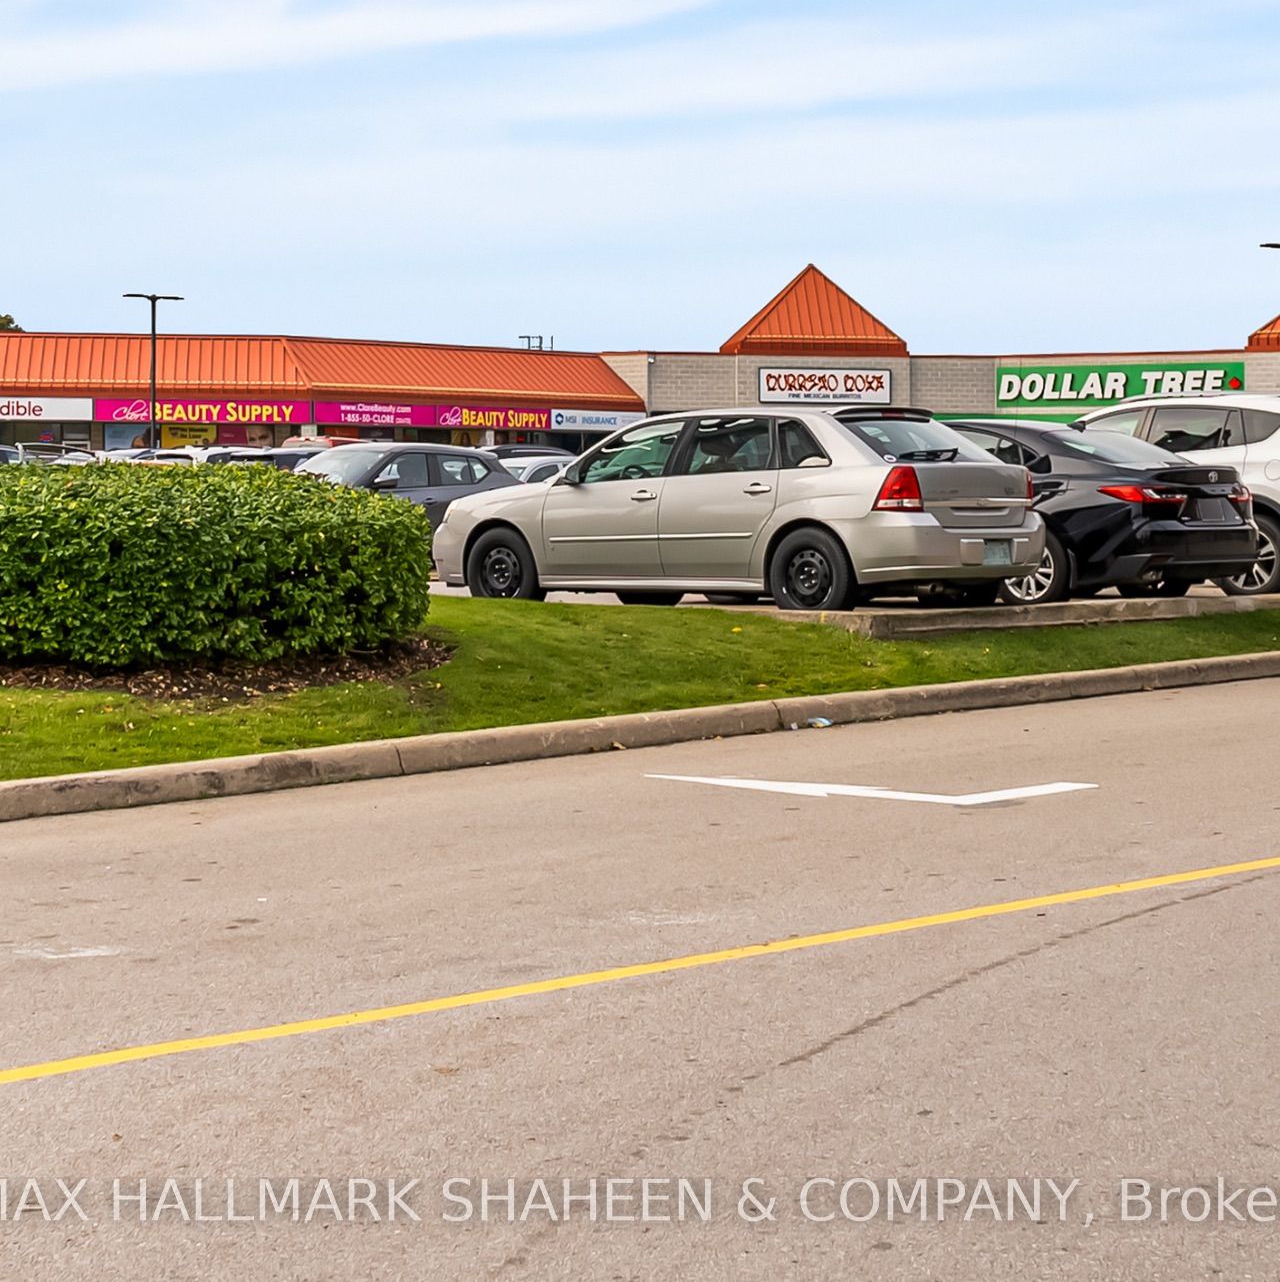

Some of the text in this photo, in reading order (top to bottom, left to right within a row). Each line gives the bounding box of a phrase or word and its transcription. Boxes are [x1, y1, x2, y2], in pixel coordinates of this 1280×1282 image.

[998, 370, 1225, 400] DOLLAR TREE
[154, 402, 221, 421] BEAUTY
[226, 402, 294, 422] SUPPLY
[462, 408, 505, 428] BEAUTY
[508, 410, 548, 429] SUPPLY
[581, 416, 617, 426] INSURANCE
